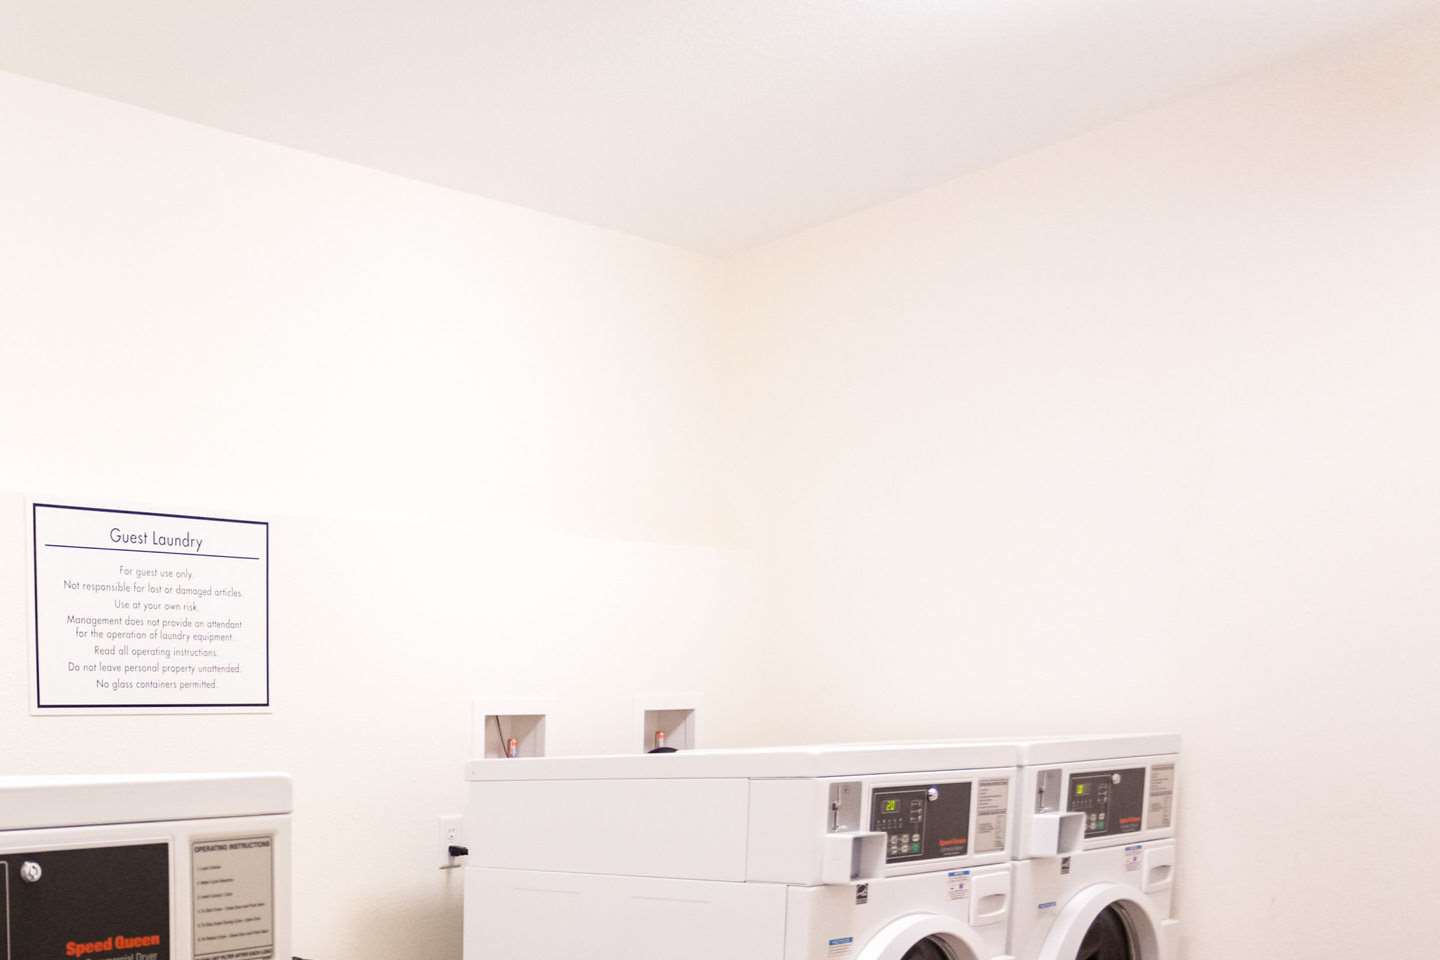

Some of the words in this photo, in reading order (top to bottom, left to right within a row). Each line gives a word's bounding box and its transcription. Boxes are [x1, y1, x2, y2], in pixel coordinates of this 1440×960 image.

[110, 527, 148, 545] Guest
[152, 531, 203, 552] Laundry
[119, 565, 133, 576] For
[135, 568, 158, 580] guest
[160, 569, 174, 578] use
[63, 579, 80, 590] Not
[82, 582, 131, 593] responsible
[133, 581, 145, 593] for
[148, 583, 162, 594] lost
[164, 586, 172, 594] or
[175, 584, 213, 598] damaged
[114, 599, 130, 609] Use
[132, 600, 141, 609] at
[143, 602, 161, 612] your
[164, 603, 181, 611] own
[66, 615, 122, 628] Management
[124, 616, 144, 626] does
[146, 618, 160, 627] not
[162, 618, 192, 629] provide
[194, 620, 205, 628] an
[206, 619, 242, 629] attendant
[75, 626, 88, 638] for
[90, 627, 104, 639] the
[106, 630, 147, 641] operation
[149, 629, 158, 640] of
[159, 630, 190, 643] laundry
[94, 644, 116, 655] Read
[118, 644, 129, 656] all
[131, 647, 171, 659] operating
[67, 661, 81, 672] Do
[83, 663, 97, 672] not
[99, 661, 122, 672] leave
[124, 661, 160, 675] personal
[161, 664, 195, 675] property
[96, 679, 110, 689] No
[112, 679, 134, 692] glass
[135, 679, 177, 689] containers
[65, 937, 112, 957] Speed
[115, 934, 160, 951] Queen
